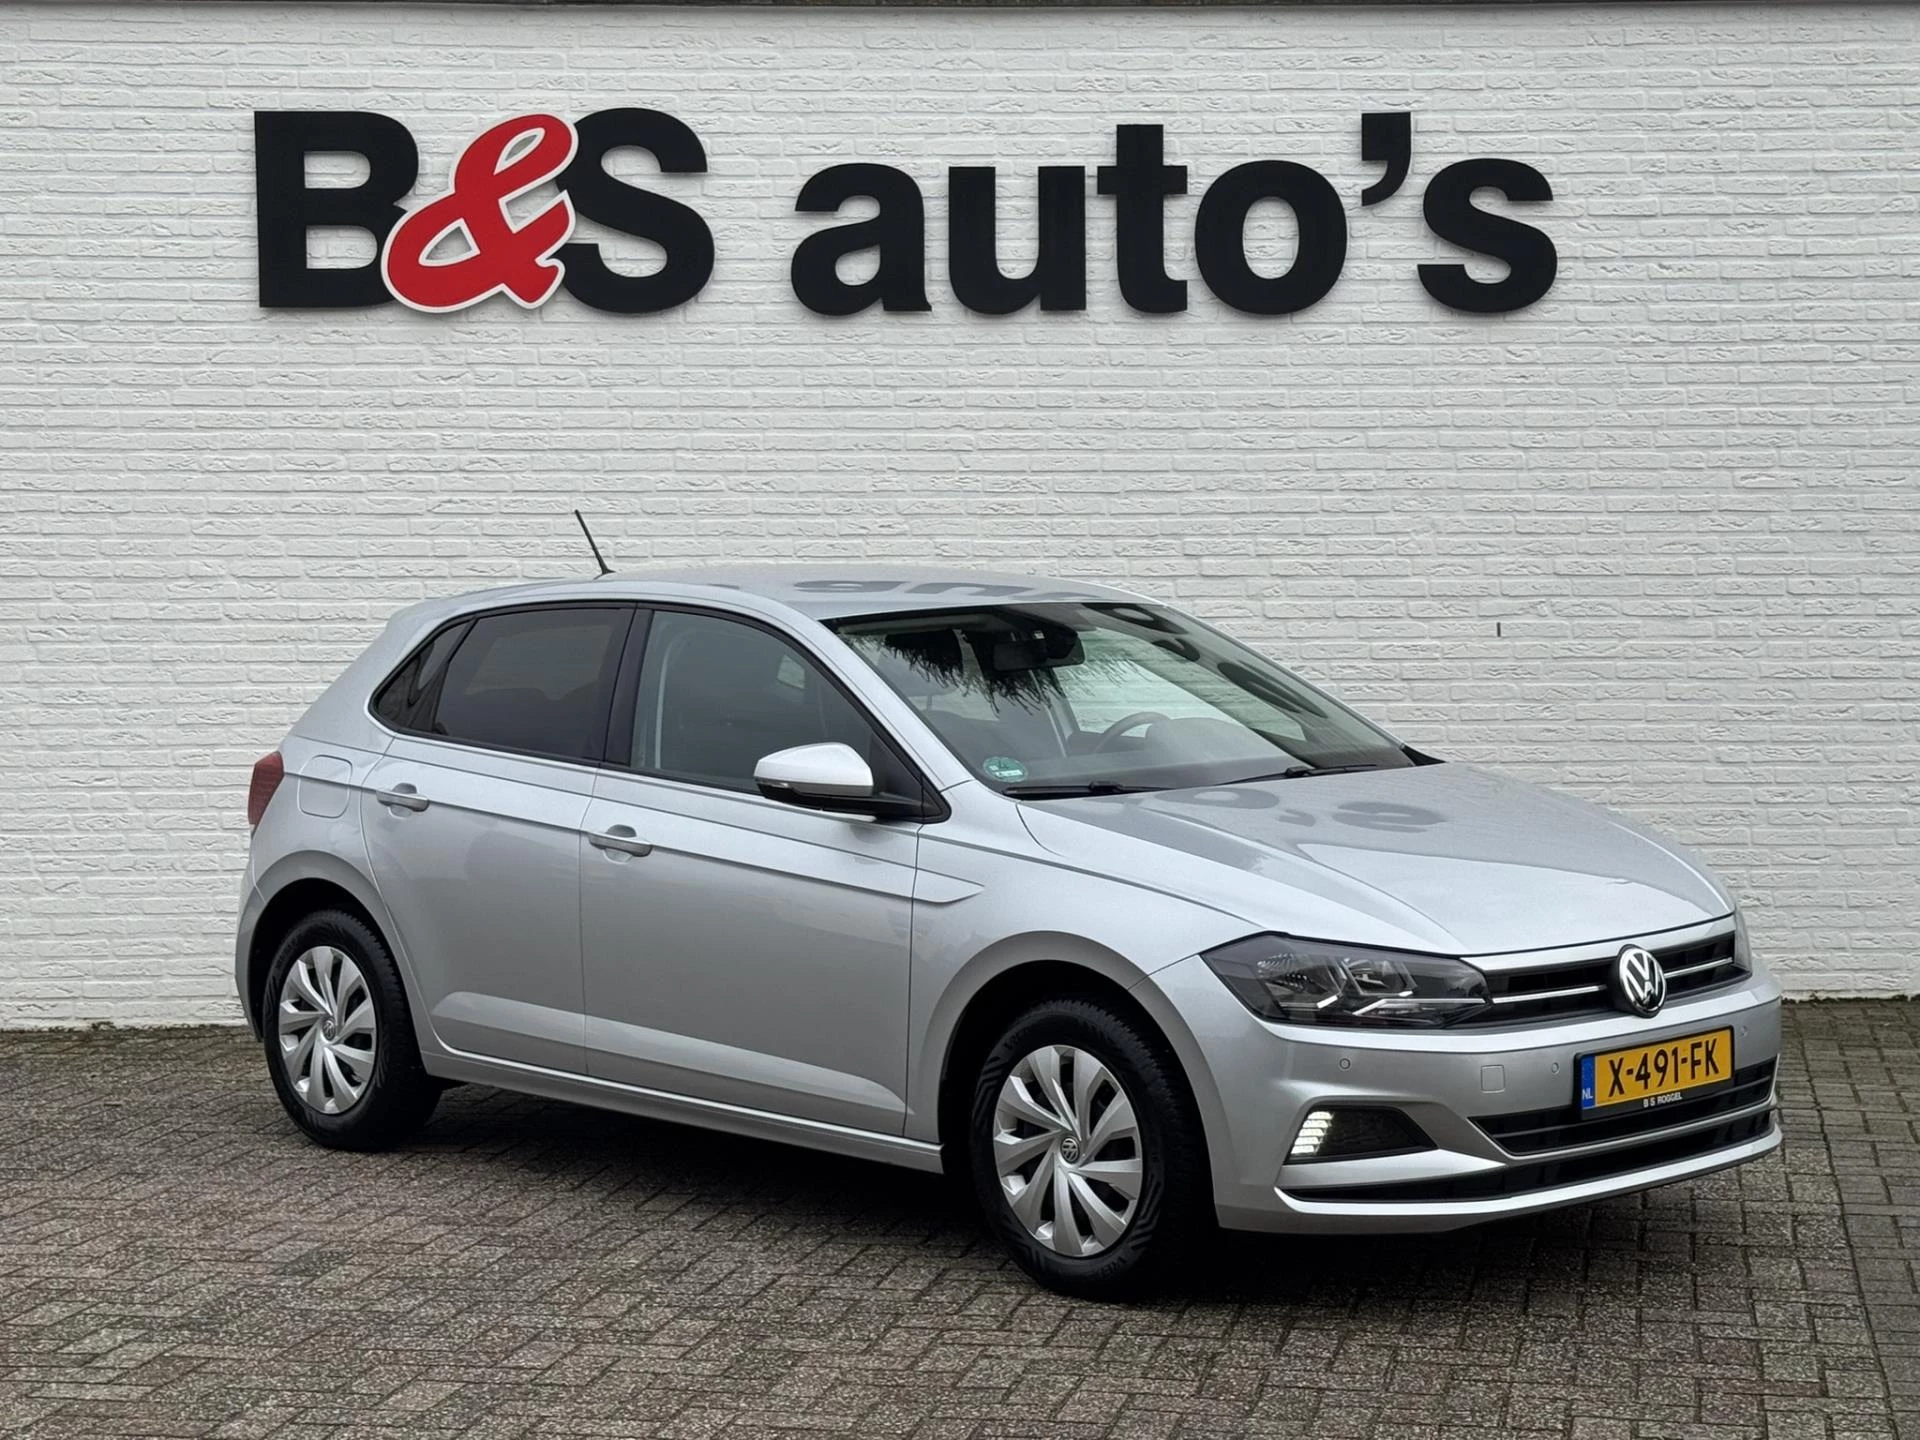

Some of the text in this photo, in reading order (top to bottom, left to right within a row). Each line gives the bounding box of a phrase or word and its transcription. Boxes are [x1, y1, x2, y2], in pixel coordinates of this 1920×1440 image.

[254, 107, 1558, 315] B&S auto's
[1582, 1087, 1593, 1100] NL
[1608, 1038, 1720, 1098] X-491-FK
